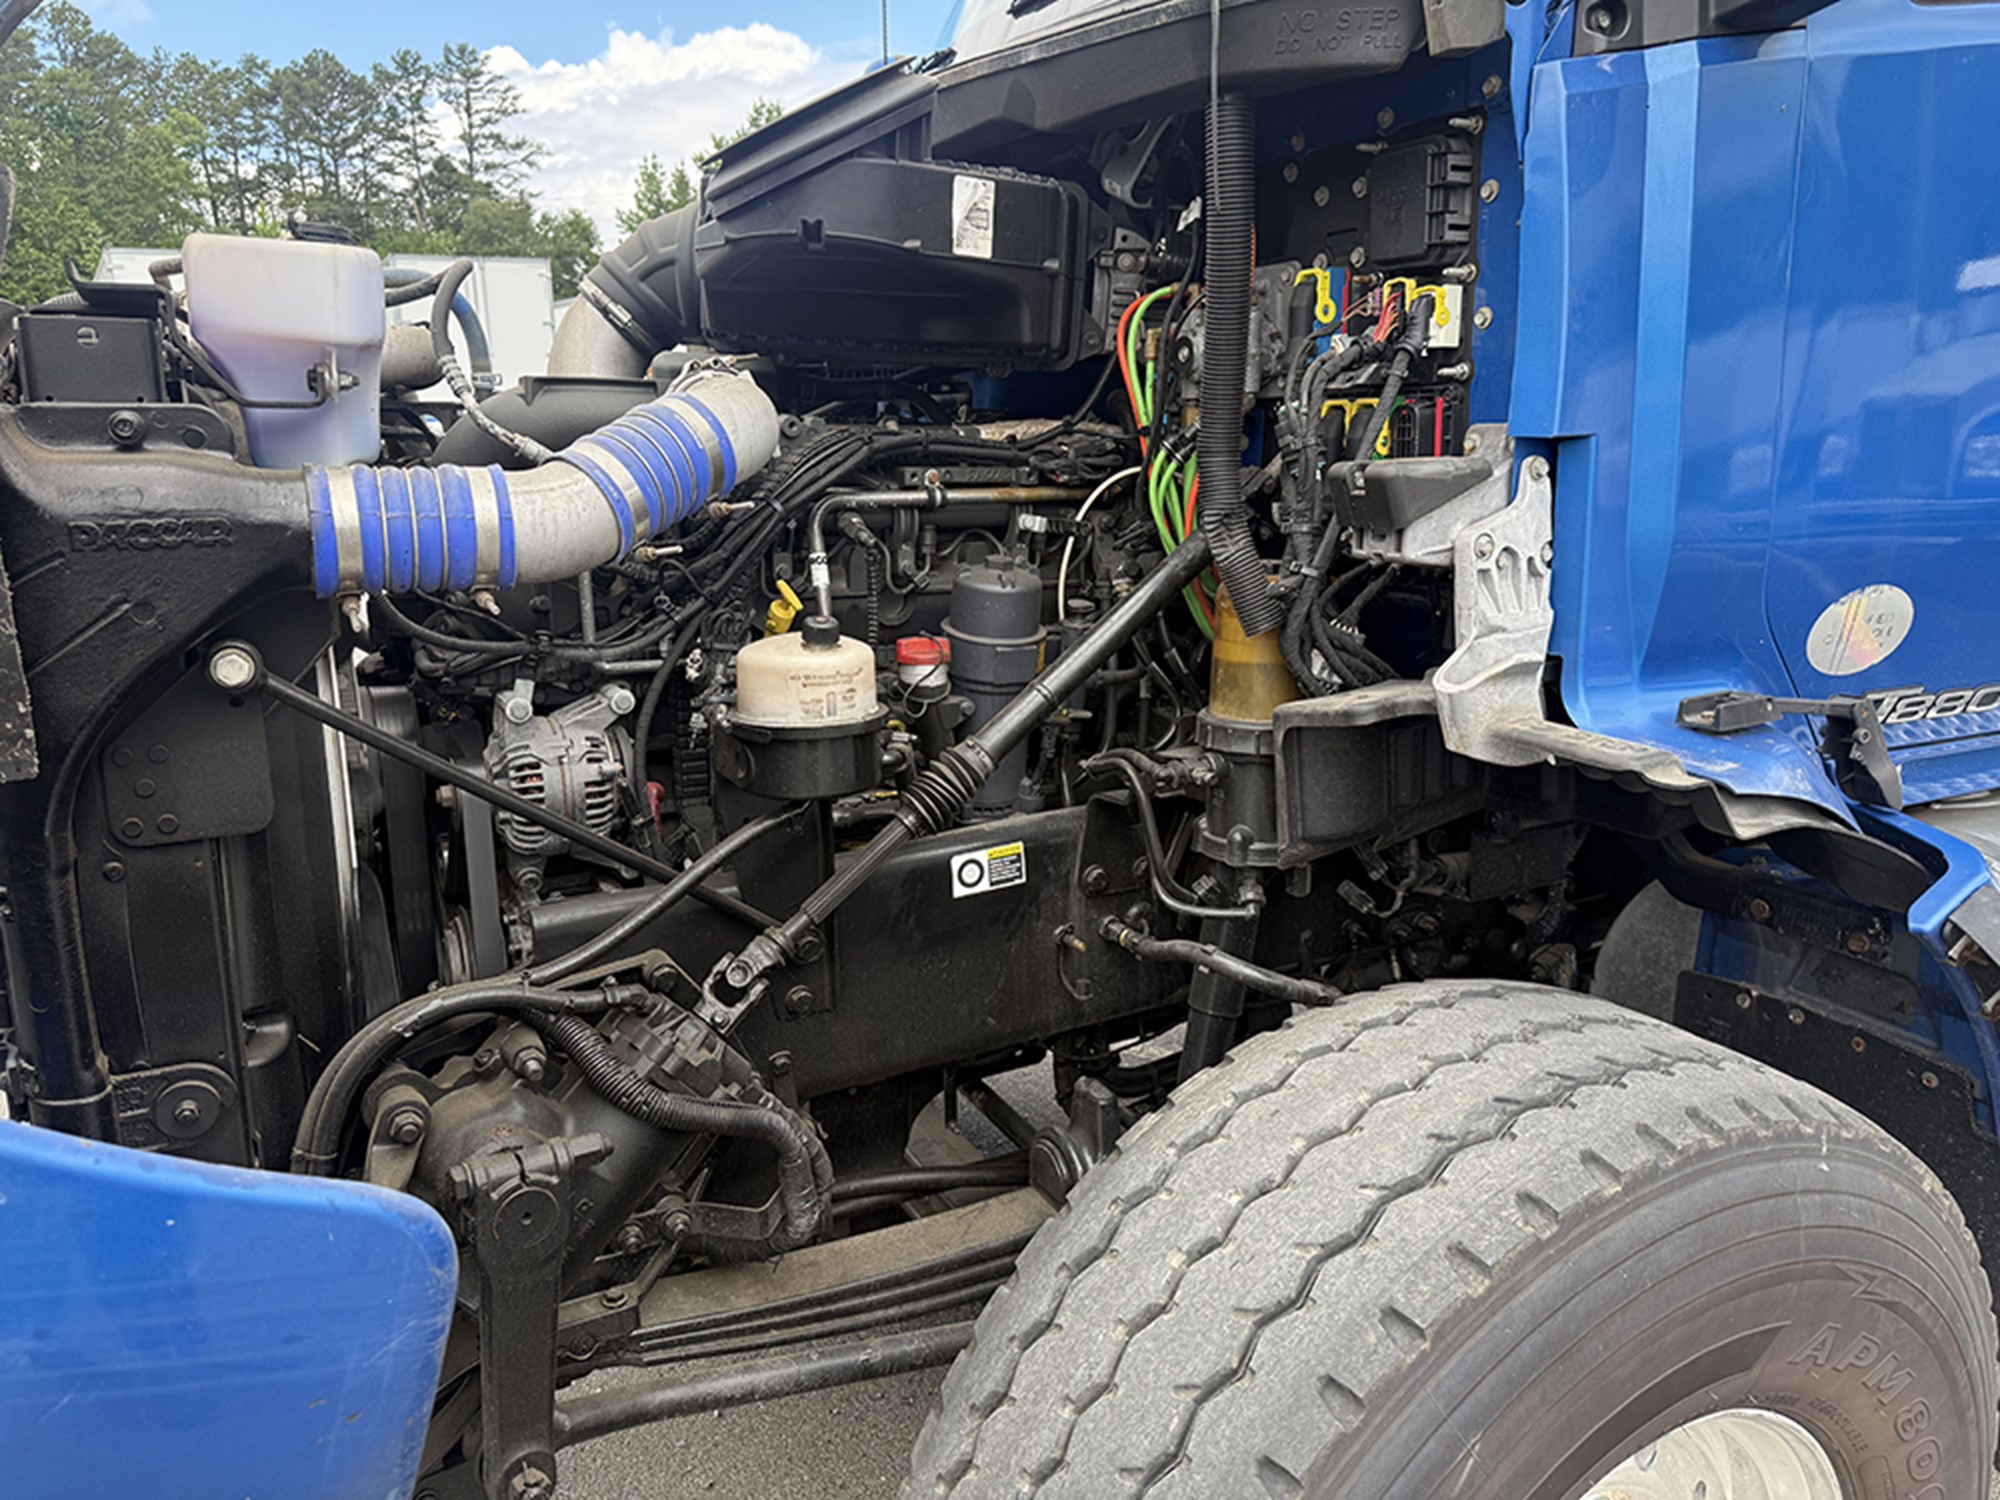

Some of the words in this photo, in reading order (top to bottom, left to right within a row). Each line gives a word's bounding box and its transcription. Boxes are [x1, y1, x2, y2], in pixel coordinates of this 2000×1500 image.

[1278, 9, 1319, 34] NO
[1336, 7, 1401, 31] STEP
[1273, 35, 1302, 55] DO
[1312, 33, 1351, 52] NOT
[1361, 31, 1403, 49] PULL
[67, 516, 234, 552] PACCAR
